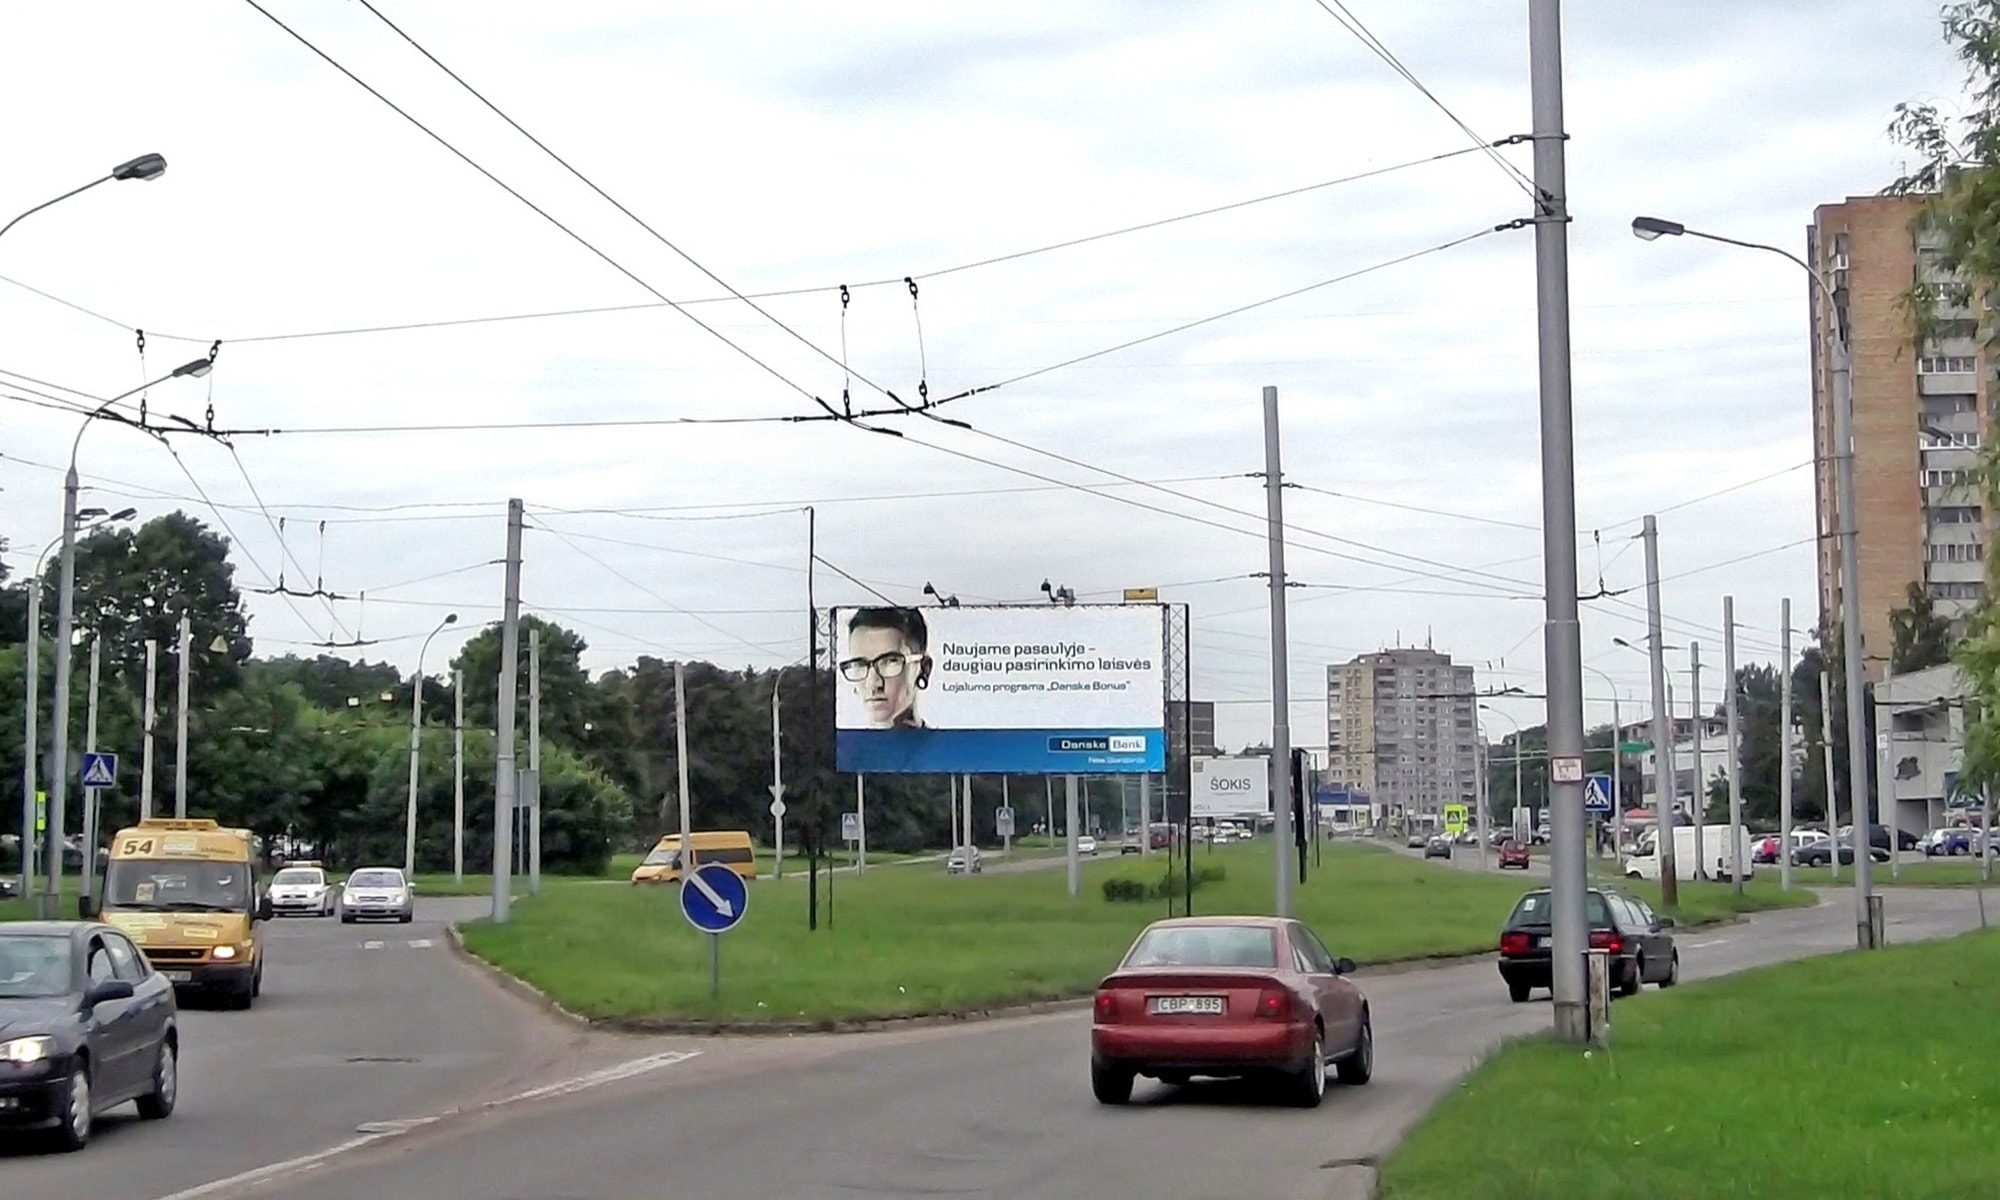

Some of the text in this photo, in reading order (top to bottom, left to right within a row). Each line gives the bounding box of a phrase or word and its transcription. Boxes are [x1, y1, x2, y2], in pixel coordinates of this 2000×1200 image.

[943, 642, 1011, 658] Naujame
[1014, 642, 1085, 658] pasaulyje
[943, 657, 1151, 674] daugiau pasirinkimo laisvės
[942, 682, 991, 693] Lojalumo
[993, 684, 1044, 693] programa
[1061, 740, 1142, 749] Danske Bank
[123, 840, 153, 855] 54
[1160, 999, 1187, 1010] CBP
